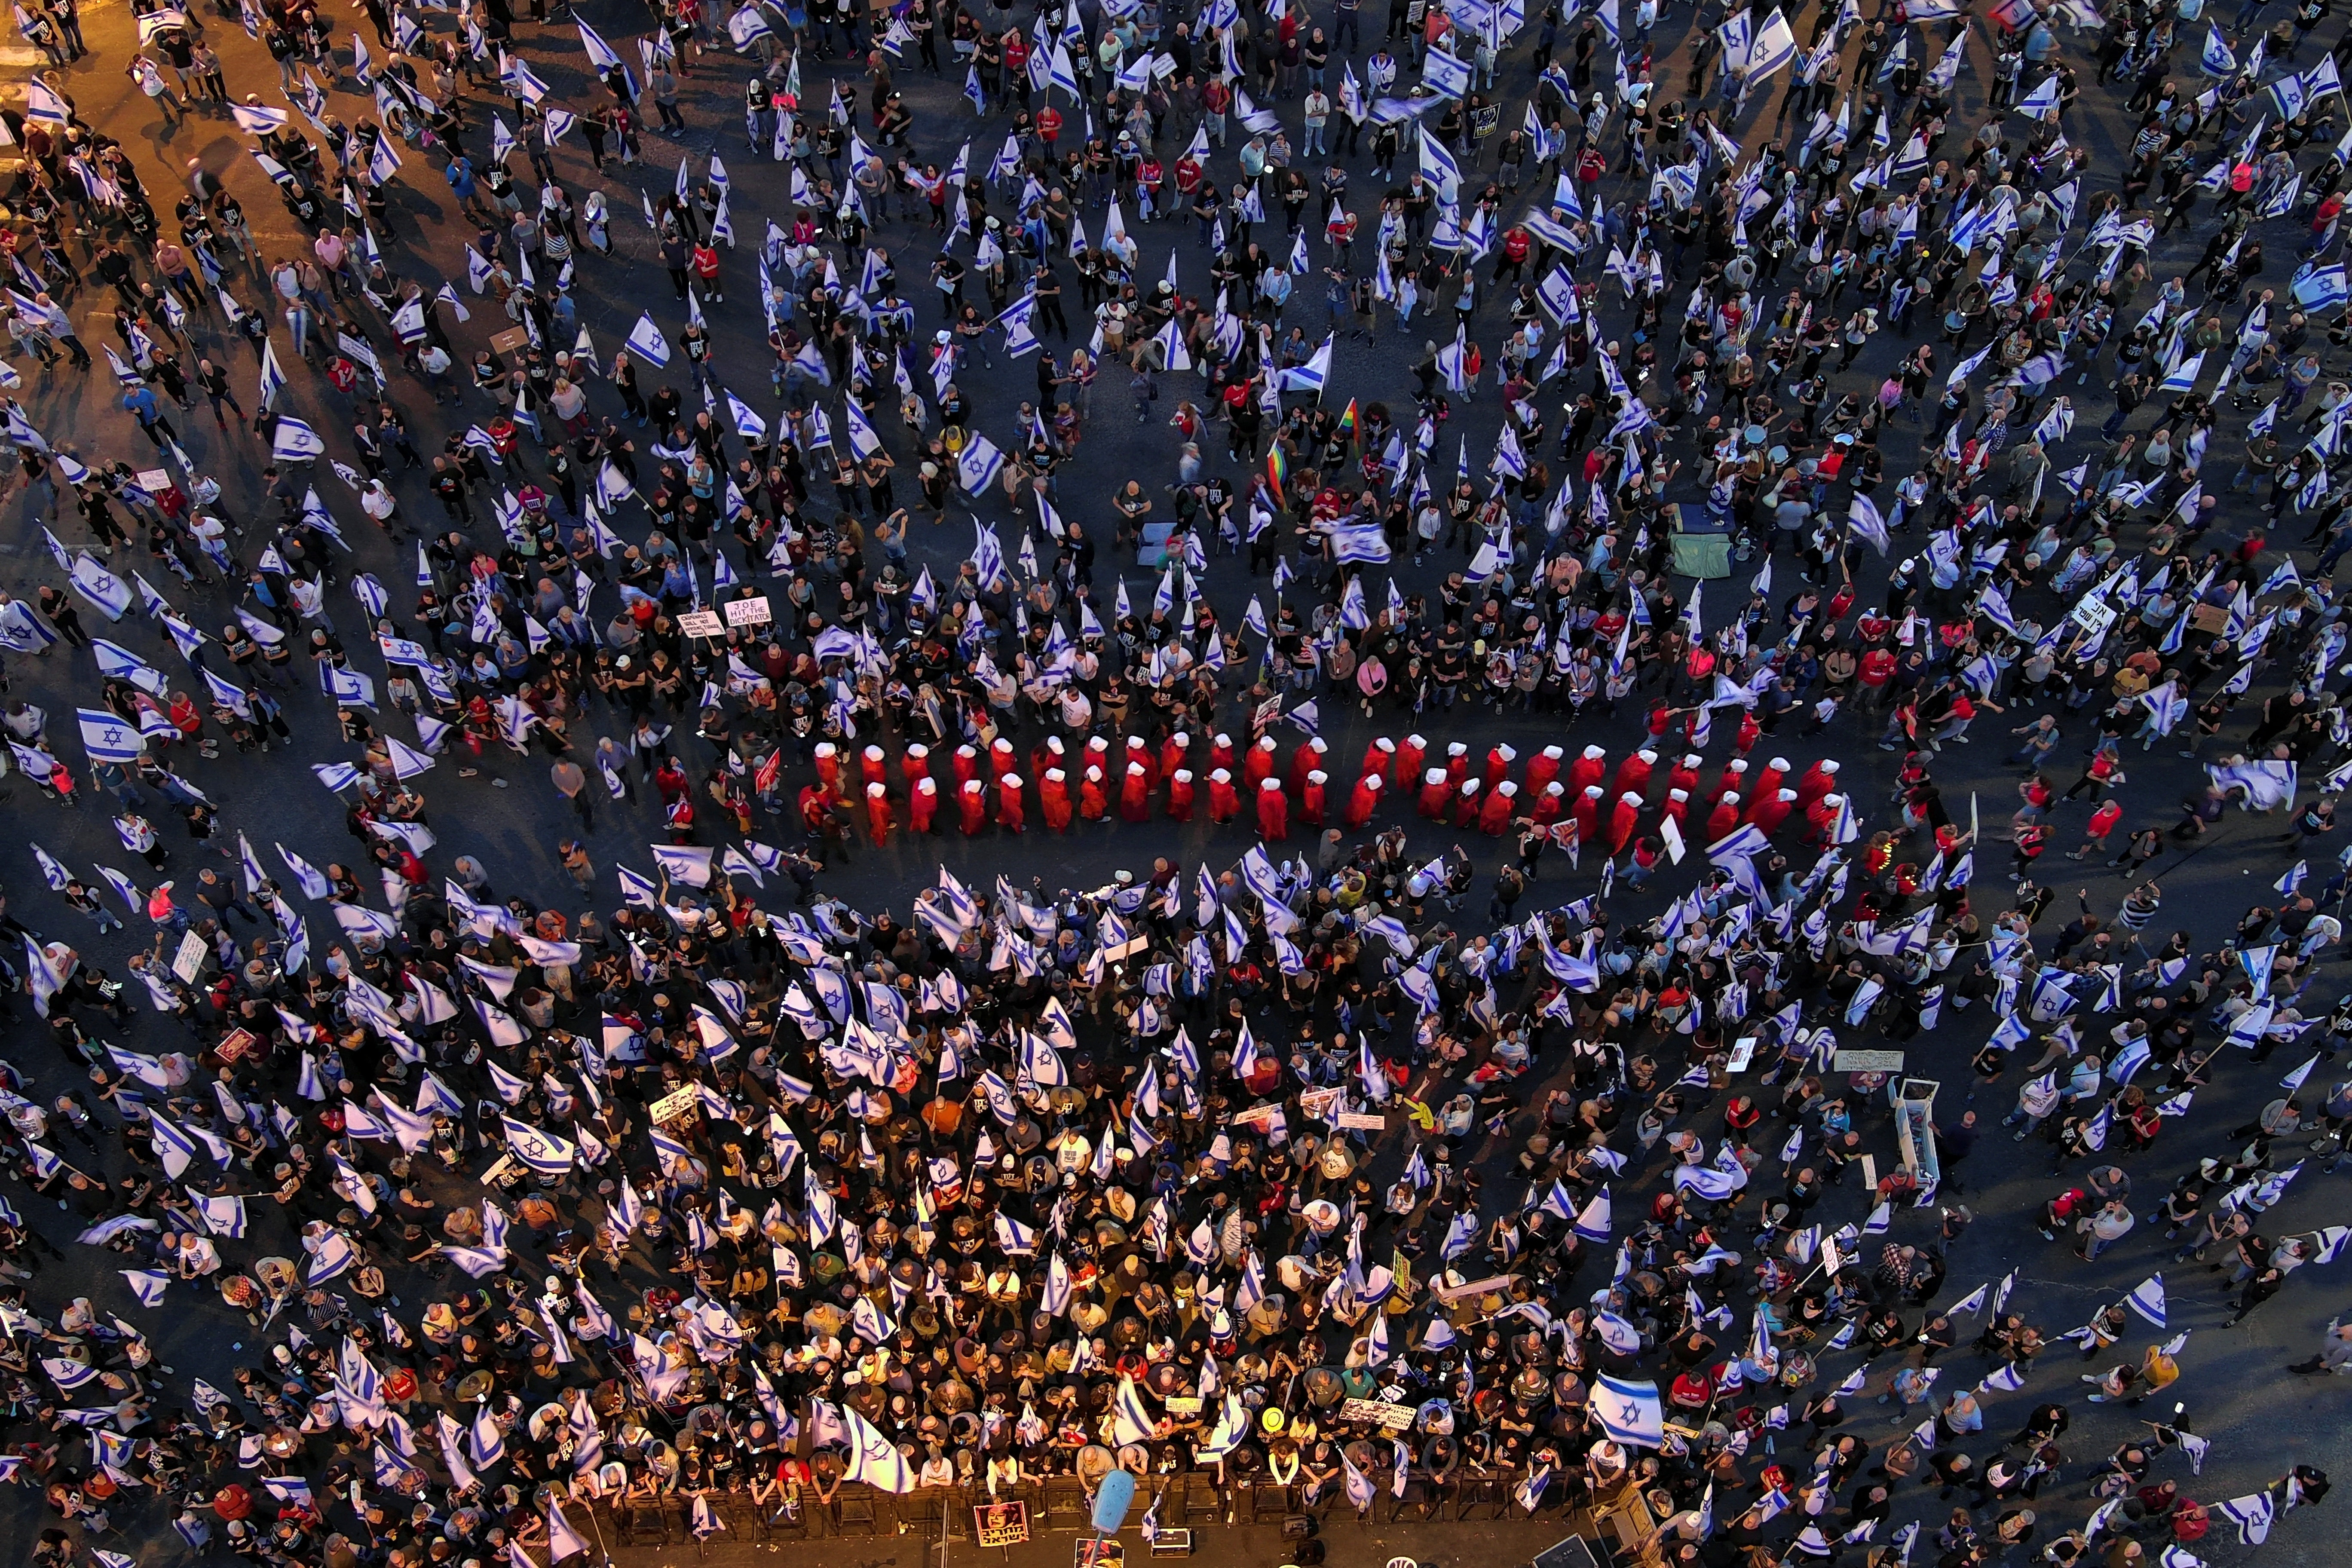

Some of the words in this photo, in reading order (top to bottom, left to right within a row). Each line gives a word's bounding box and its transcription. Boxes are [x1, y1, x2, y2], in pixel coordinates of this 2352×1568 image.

[734, 600, 756, 609] JOE
[2091, 602, 2107, 618] אני
[731, 609, 746, 617] HIT
[656, 1090, 694, 1115] ENEMY
[655, 1097, 695, 1122] DEMOCRACY
[982, 1526, 1024, 1537] מחריב
[983, 1533, 1025, 1544] ישראל
